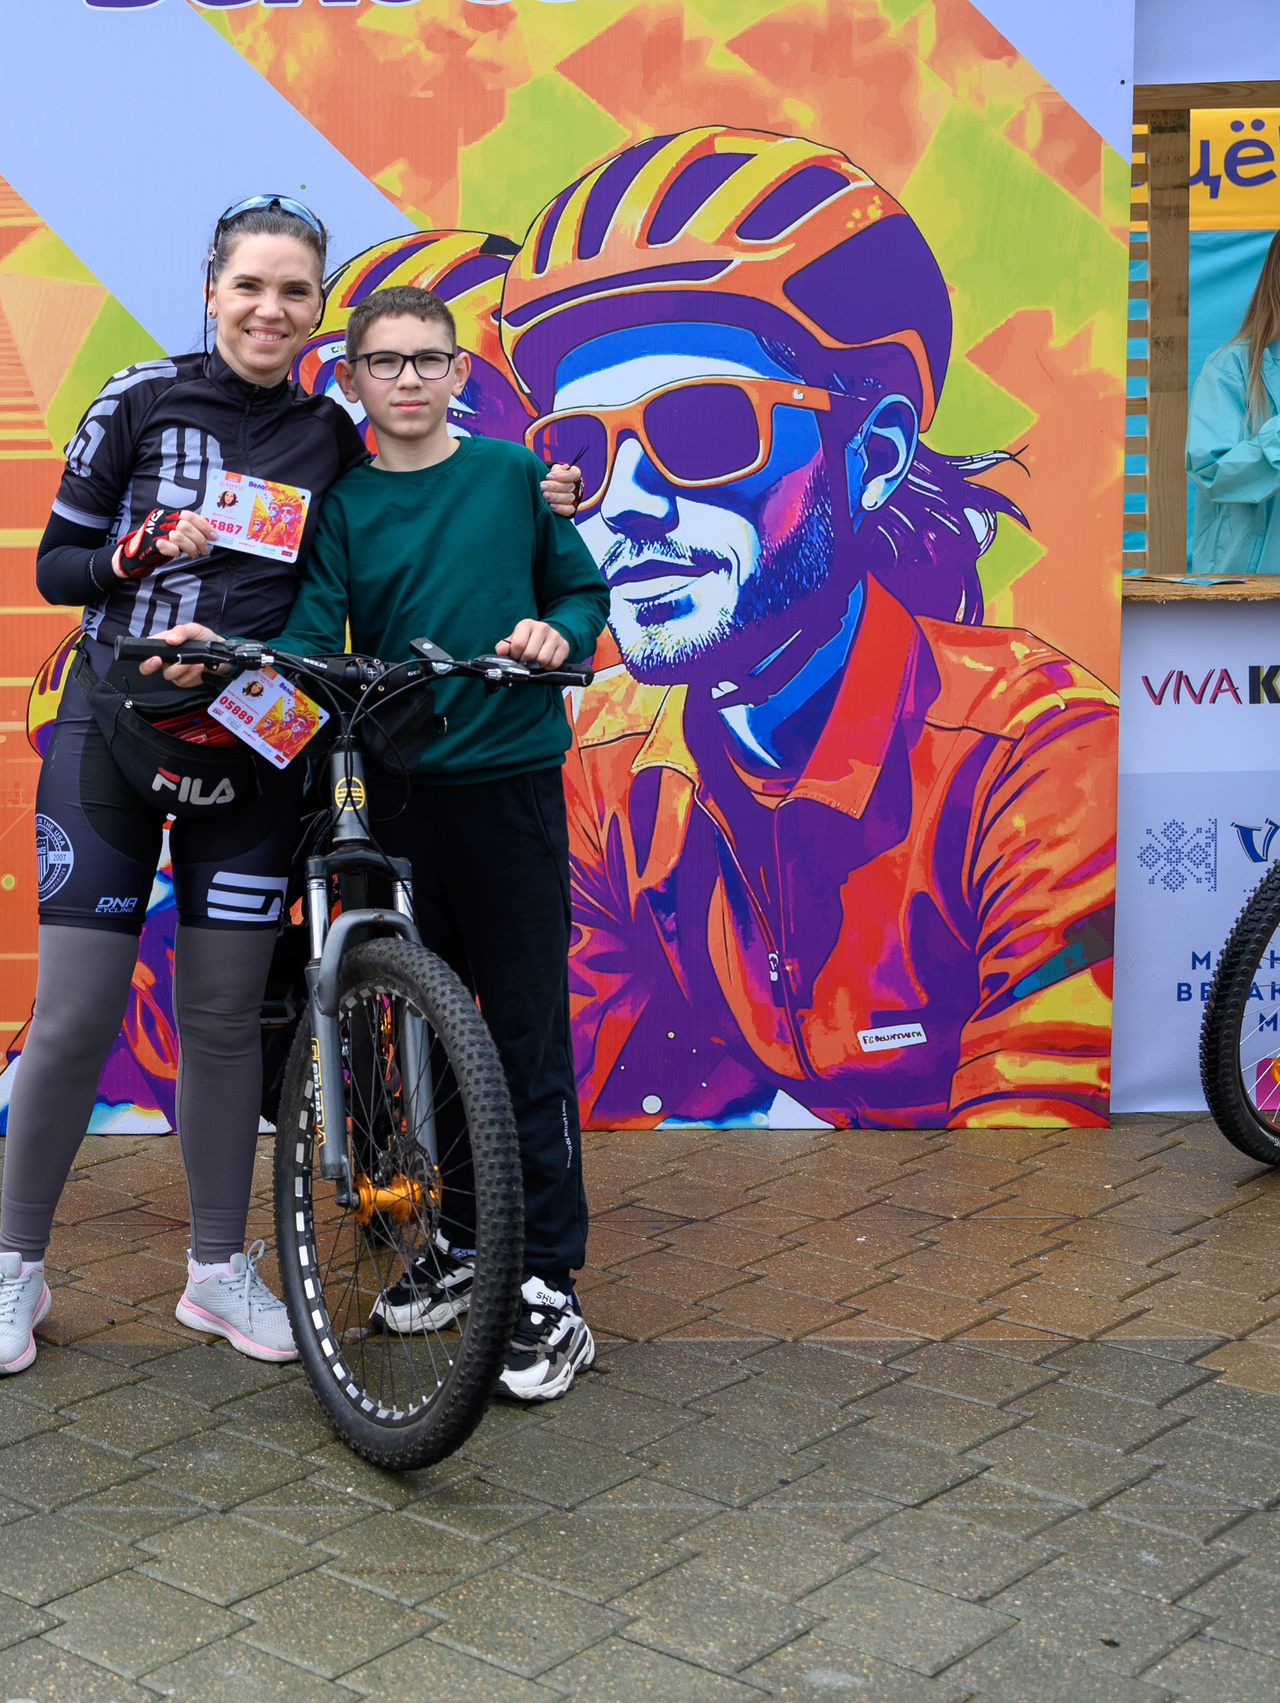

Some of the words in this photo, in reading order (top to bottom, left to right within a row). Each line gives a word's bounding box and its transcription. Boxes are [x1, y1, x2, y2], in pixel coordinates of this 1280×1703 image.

[204, 517, 243, 535] 5887
[1142, 669, 1242, 705] VIVA
[219, 695, 254, 725] 05889
[152, 766, 235, 805] FILA
[54, 829, 65, 847] USA
[53, 853, 67, 862] 2007
[97, 897, 138, 908] DNA
